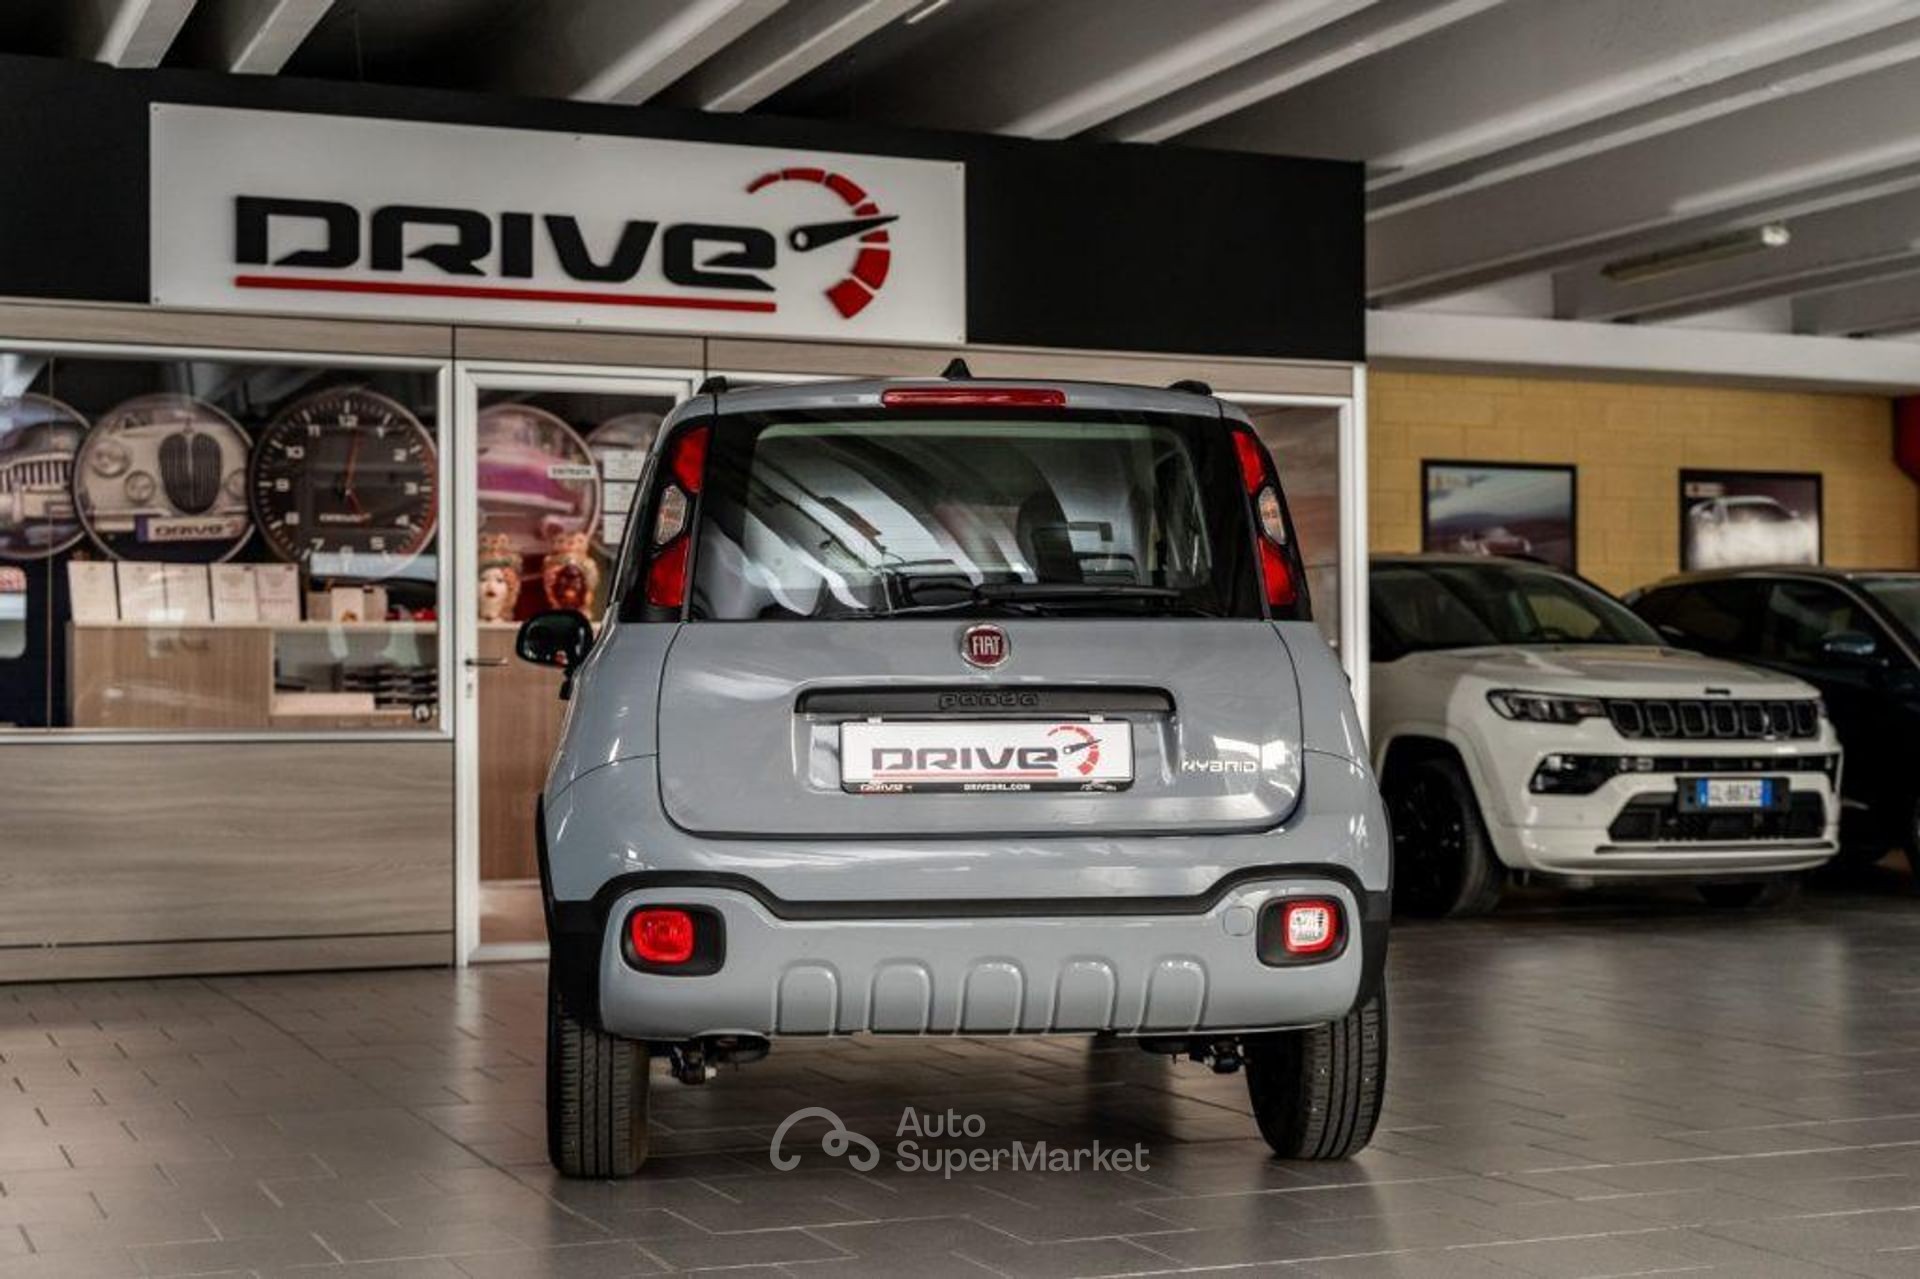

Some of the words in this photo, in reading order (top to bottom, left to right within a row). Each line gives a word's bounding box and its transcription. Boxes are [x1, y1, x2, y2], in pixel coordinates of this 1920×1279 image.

[339, 413, 358, 429] 12
[394, 448, 407, 461] 2
[404, 481, 418, 495] 3
[395, 515, 409, 526] 4
[311, 537, 325, 550] 7
[971, 635, 1001, 656] FIAT
